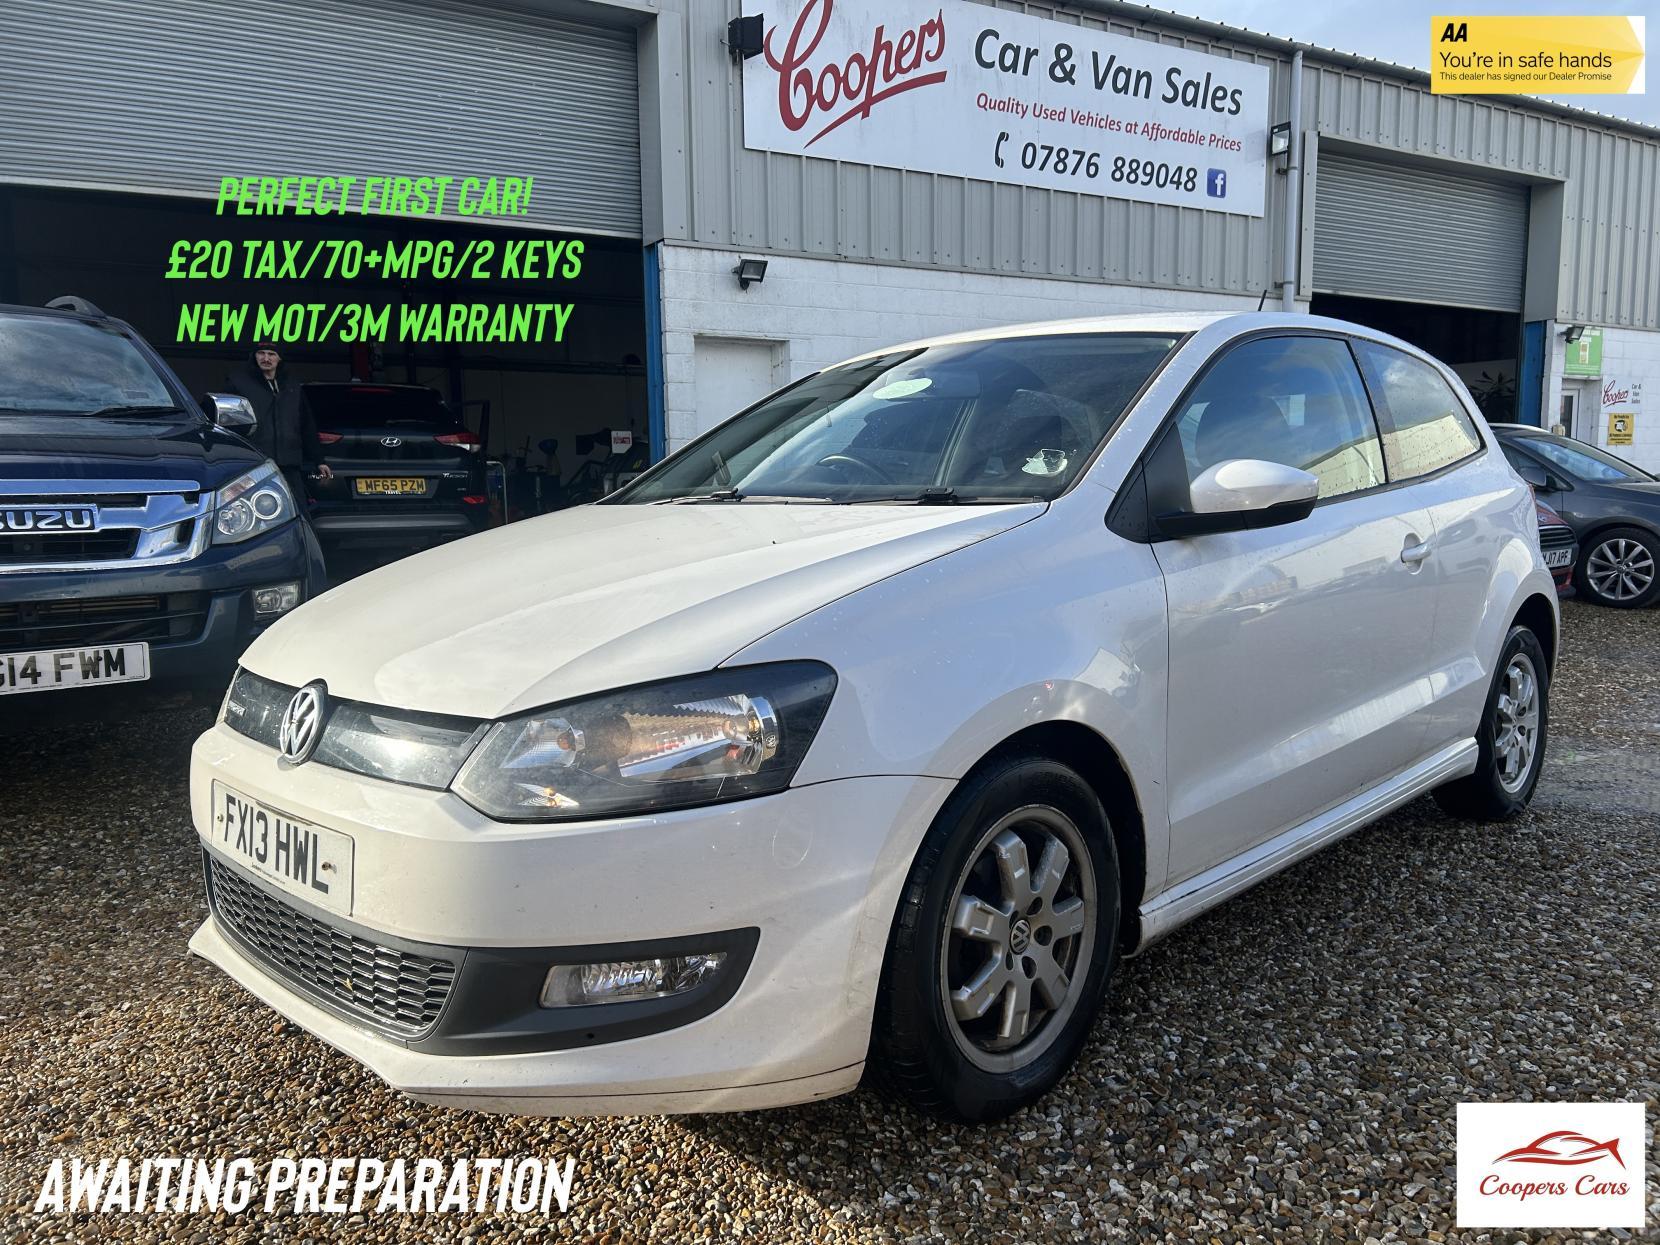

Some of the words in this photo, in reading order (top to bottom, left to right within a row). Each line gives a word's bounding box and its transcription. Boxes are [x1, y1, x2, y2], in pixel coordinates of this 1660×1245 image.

[763, 0, 945, 131] Coopers
[974, 29, 1038, 76] Car
[1048, 43, 1077, 85] &
[1091, 50, 1153, 99] Van
[1161, 67, 1243, 115] Sales
[976, 92, 1029, 119] Quality
[1032, 103, 1066, 122] Used
[1070, 110, 1122, 132] Vehicles
[1125, 120, 1139, 135] at
[1140, 122, 1205, 145] Affordable
[1208, 133, 1242, 151] Prices
[1021, 142, 1100, 178] 07876
[1111, 156, 1198, 192] 889048
[365, 479, 398, 491] MF65
[400, 479, 424, 491] PZM
[0, 510, 91, 530] UZU
[53, 648, 126, 683] FWM
[224, 793, 268, 864] FX13
[275, 818, 329, 894] HWL
